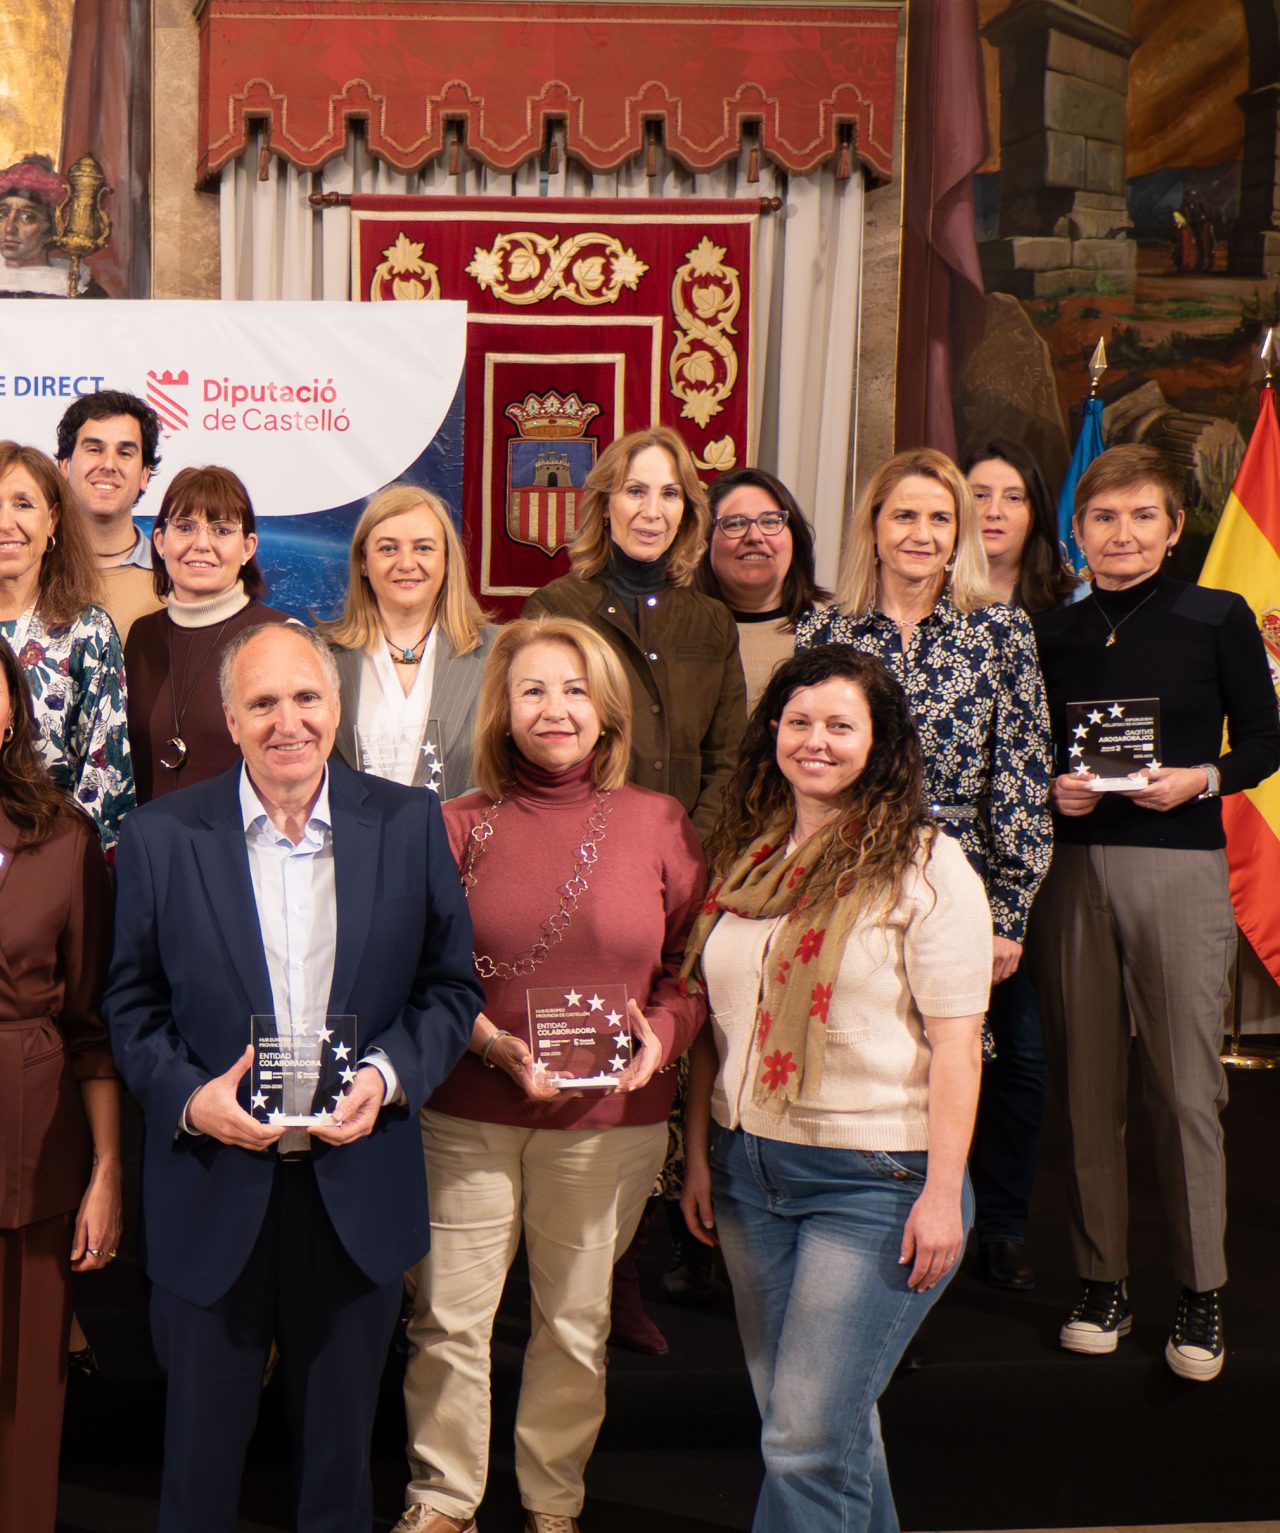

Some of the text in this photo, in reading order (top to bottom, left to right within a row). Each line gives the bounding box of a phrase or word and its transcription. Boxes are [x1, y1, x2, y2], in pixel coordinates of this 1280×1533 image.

[14, 376, 105, 397] DIRECT
[203, 377, 337, 408] Diputació
[203, 408, 351, 432] de Castelló
[537, 1027, 597, 1036] COLABORADORA
[259, 1052, 291, 1060] ENTIDAD
